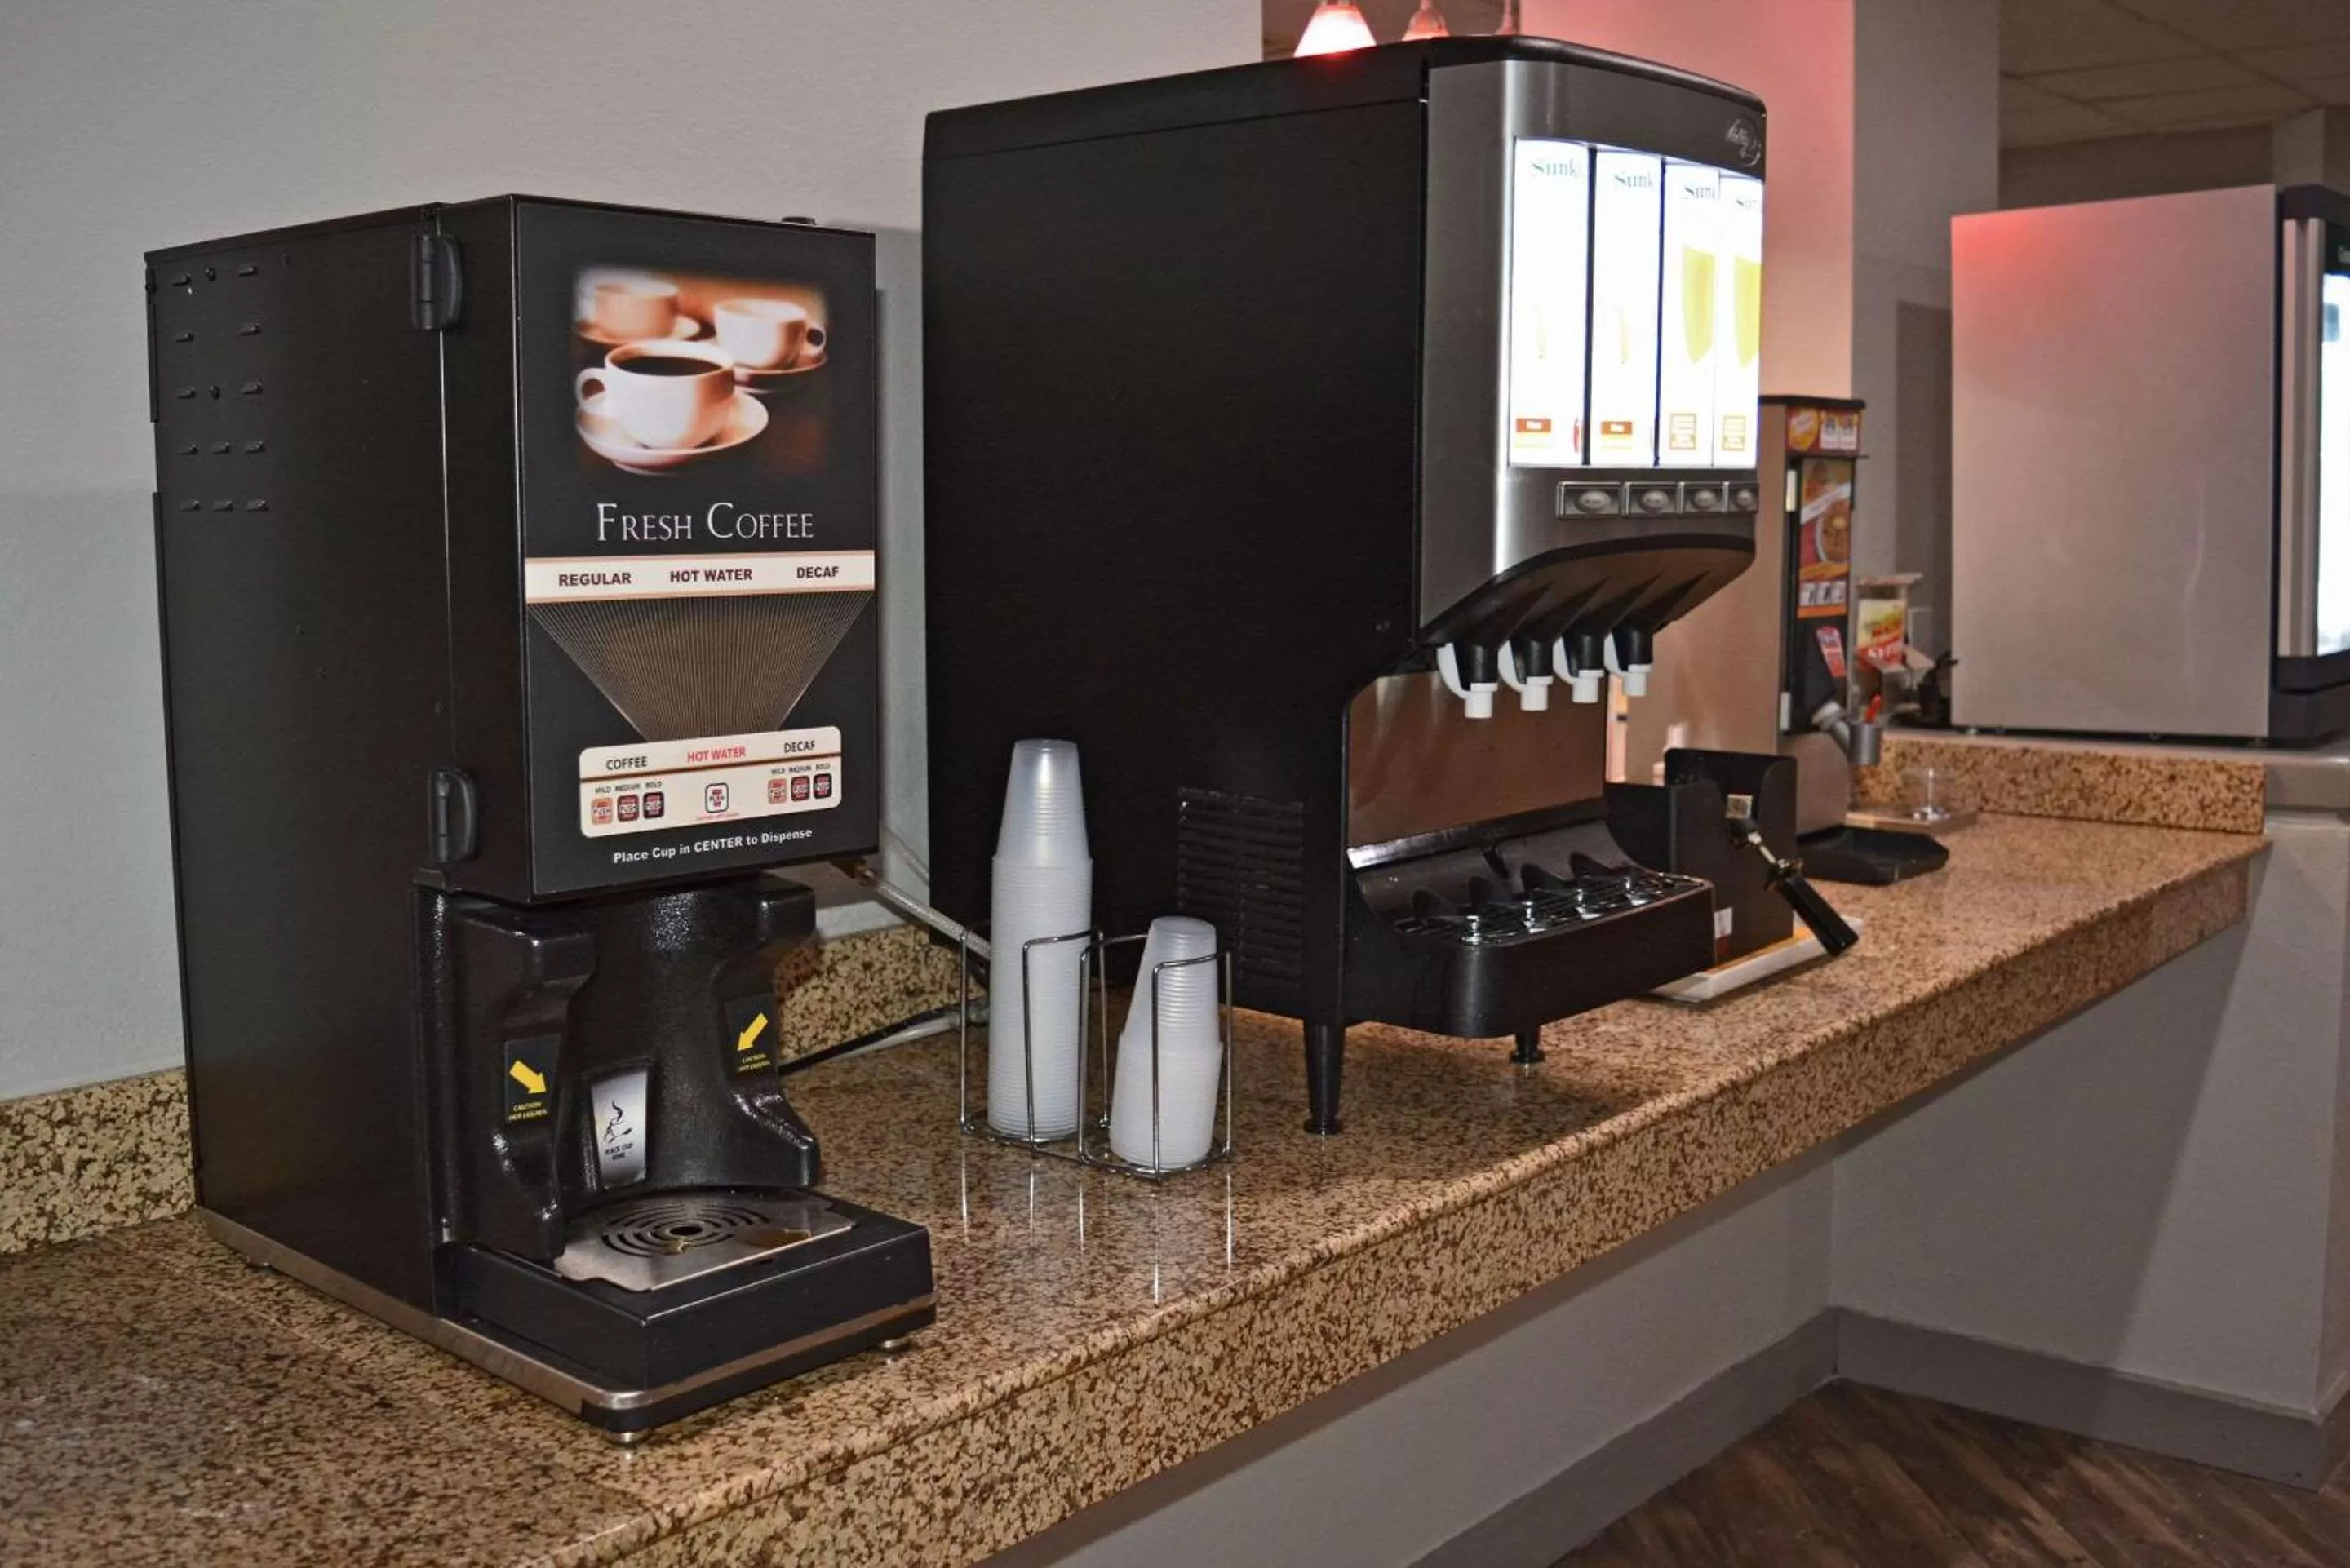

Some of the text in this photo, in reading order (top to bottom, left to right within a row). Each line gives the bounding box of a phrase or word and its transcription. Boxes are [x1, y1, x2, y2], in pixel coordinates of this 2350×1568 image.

[558, 572, 632, 587] REGULAR
[670, 569, 753, 582] HOT WATER
[796, 566, 840, 579] DECAF
[783, 740, 816, 753] DECAF
[687, 746, 747, 763] HOT WATER
[605, 755, 648, 770] COFFEE
[613, 828, 814, 864] Place Cup in CENTER to Dispense
